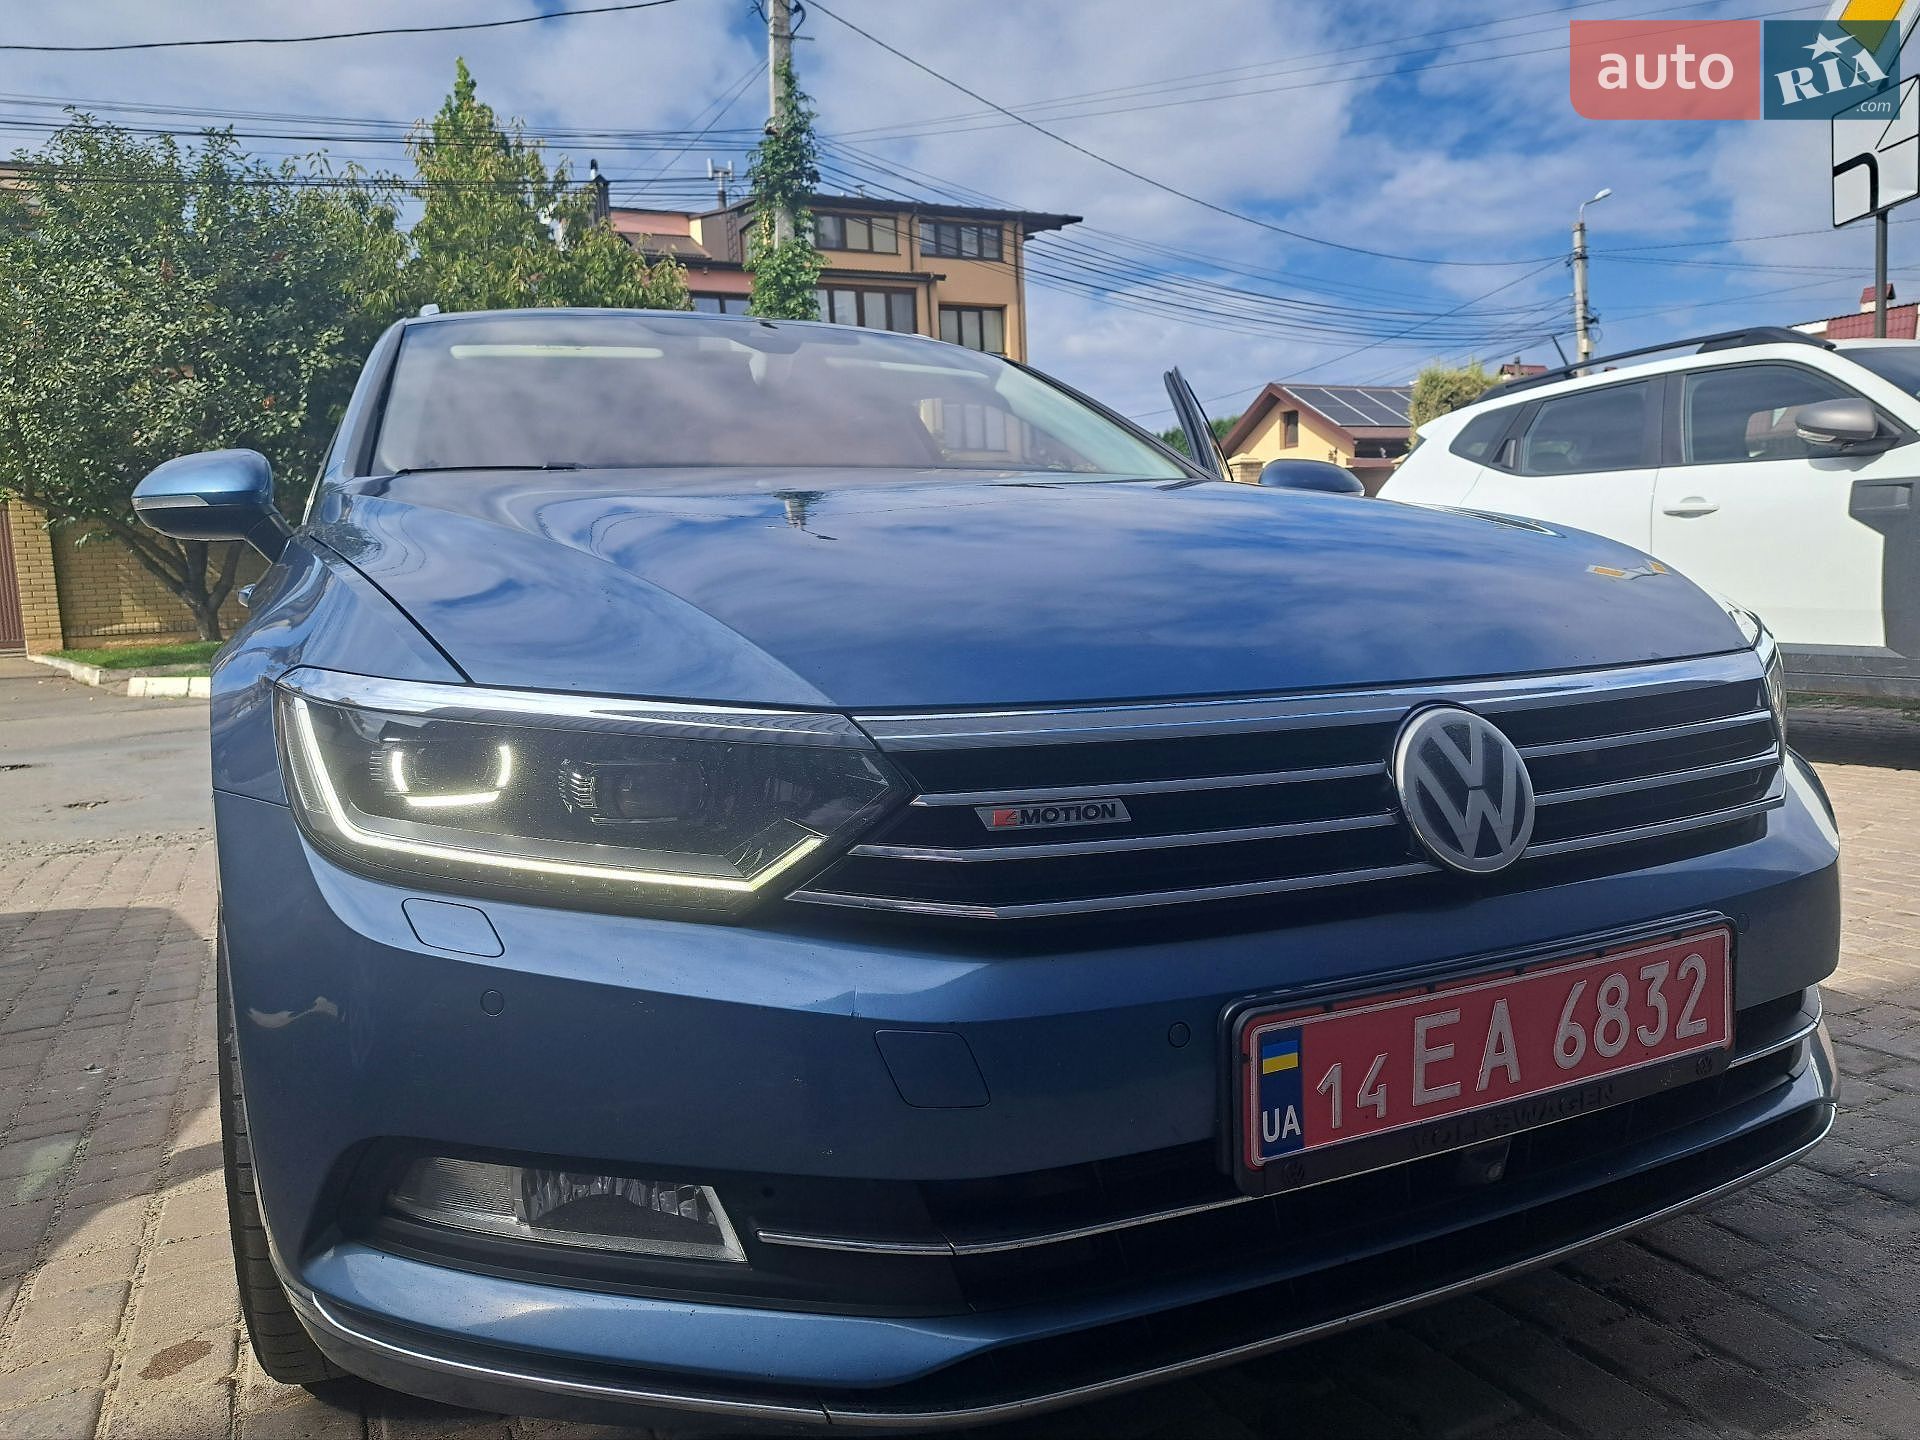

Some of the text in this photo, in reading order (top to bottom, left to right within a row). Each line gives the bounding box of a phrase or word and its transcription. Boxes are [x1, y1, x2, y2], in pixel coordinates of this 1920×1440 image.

[1316, 953, 1708, 1129] 14 EA 6832
[1262, 1105, 1302, 1143] UA
